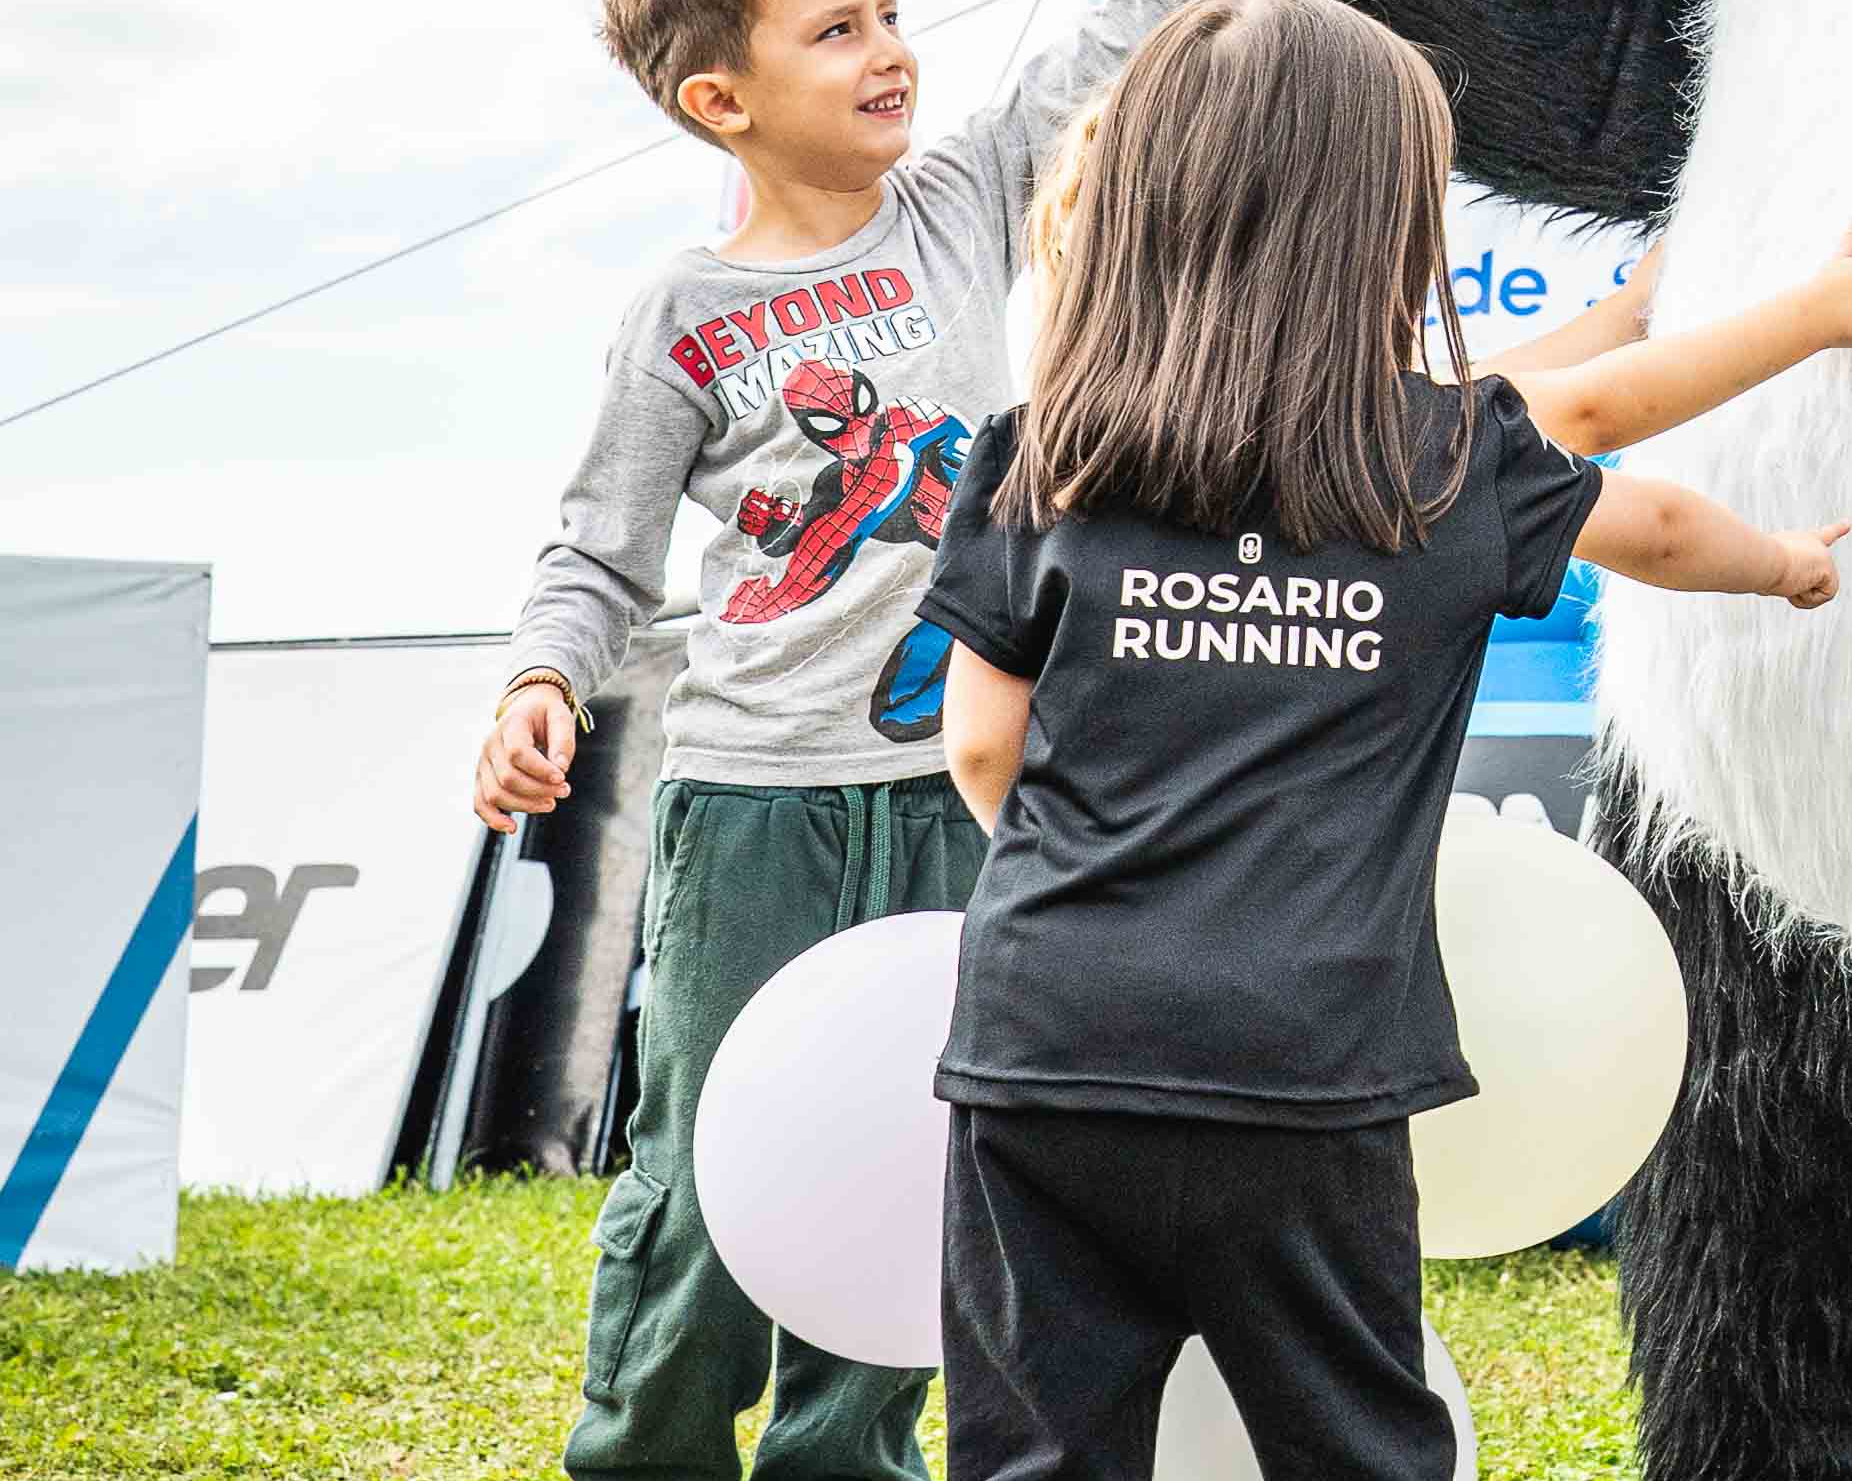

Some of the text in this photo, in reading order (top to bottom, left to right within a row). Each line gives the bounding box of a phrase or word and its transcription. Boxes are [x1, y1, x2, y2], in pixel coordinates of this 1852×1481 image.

[669, 268, 913, 389] BEYOND
[1120, 568, 1384, 622] ROSARIO
[1112, 617, 1383, 672] RUNNING
